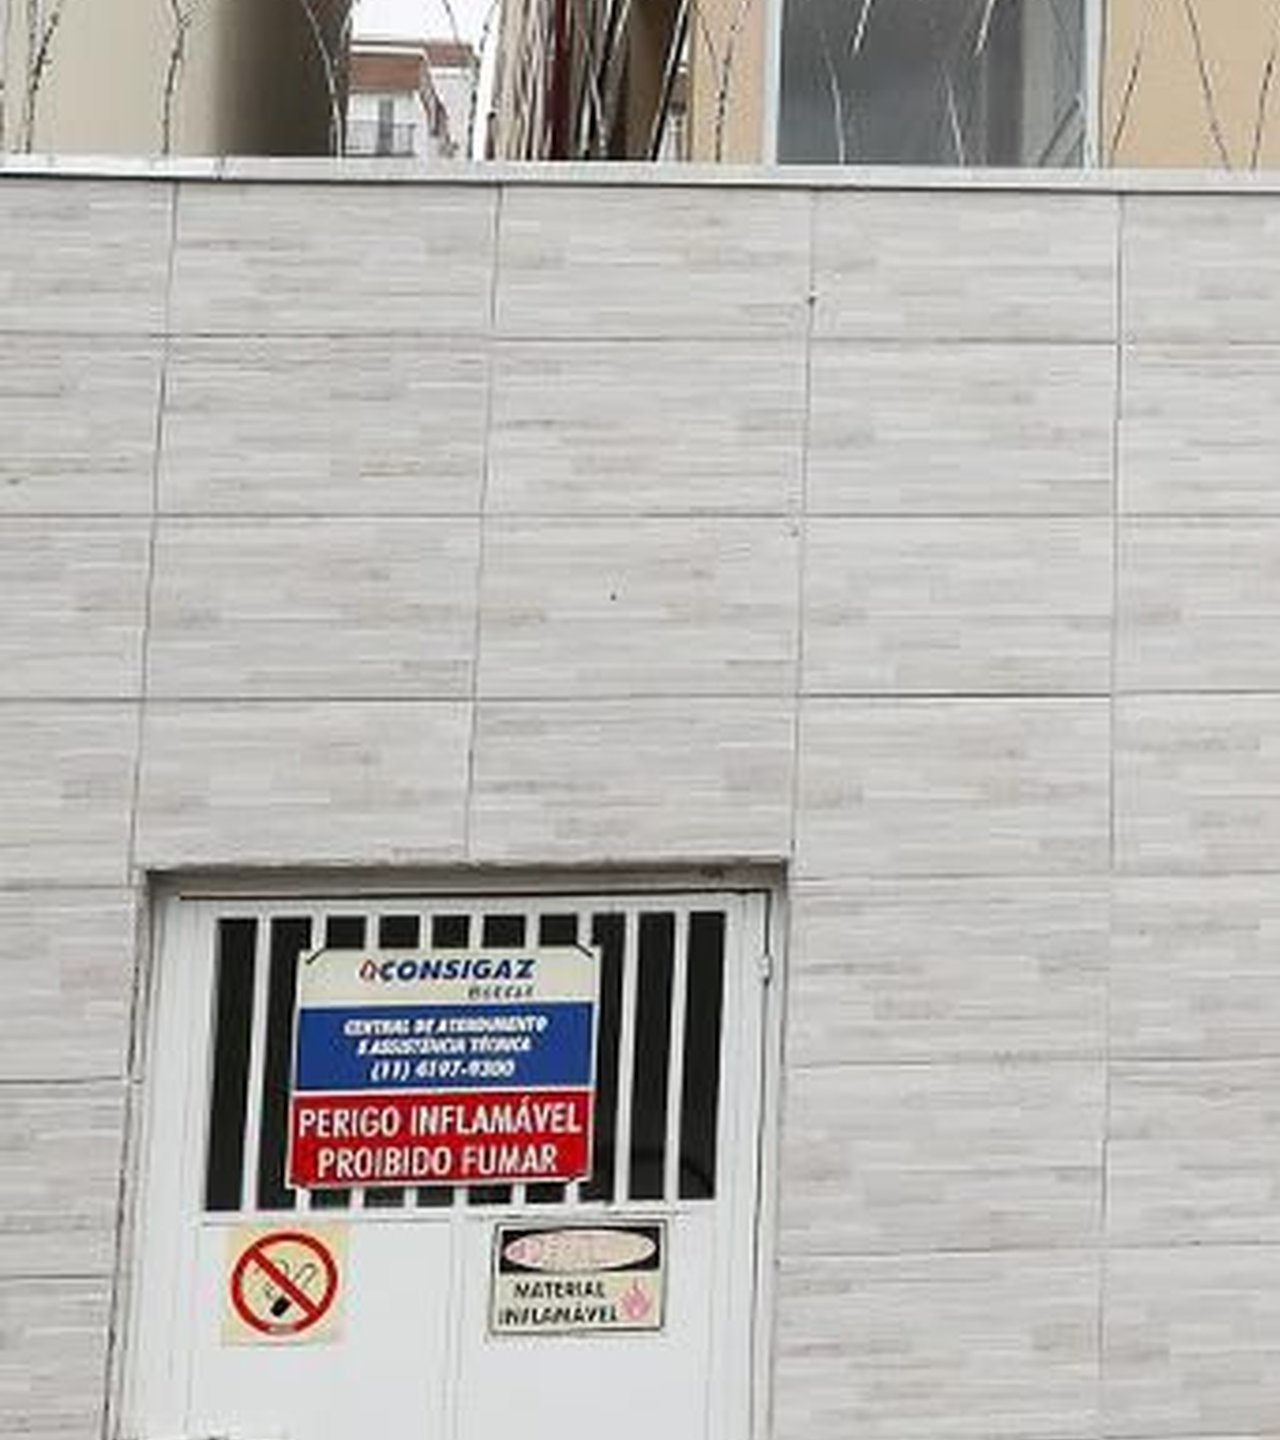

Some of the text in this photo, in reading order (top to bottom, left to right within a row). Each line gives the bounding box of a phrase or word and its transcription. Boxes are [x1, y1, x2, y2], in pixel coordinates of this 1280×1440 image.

[379, 959, 535, 982] CONSIGAZ
[370, 1060, 411, 1082] (11)
[298, 1096, 583, 1138] PERIGO INFLAMÁVEL
[317, 1143, 559, 1179] PROIBIDO FUMAR
[514, 1281, 606, 1299] MATERIAL
